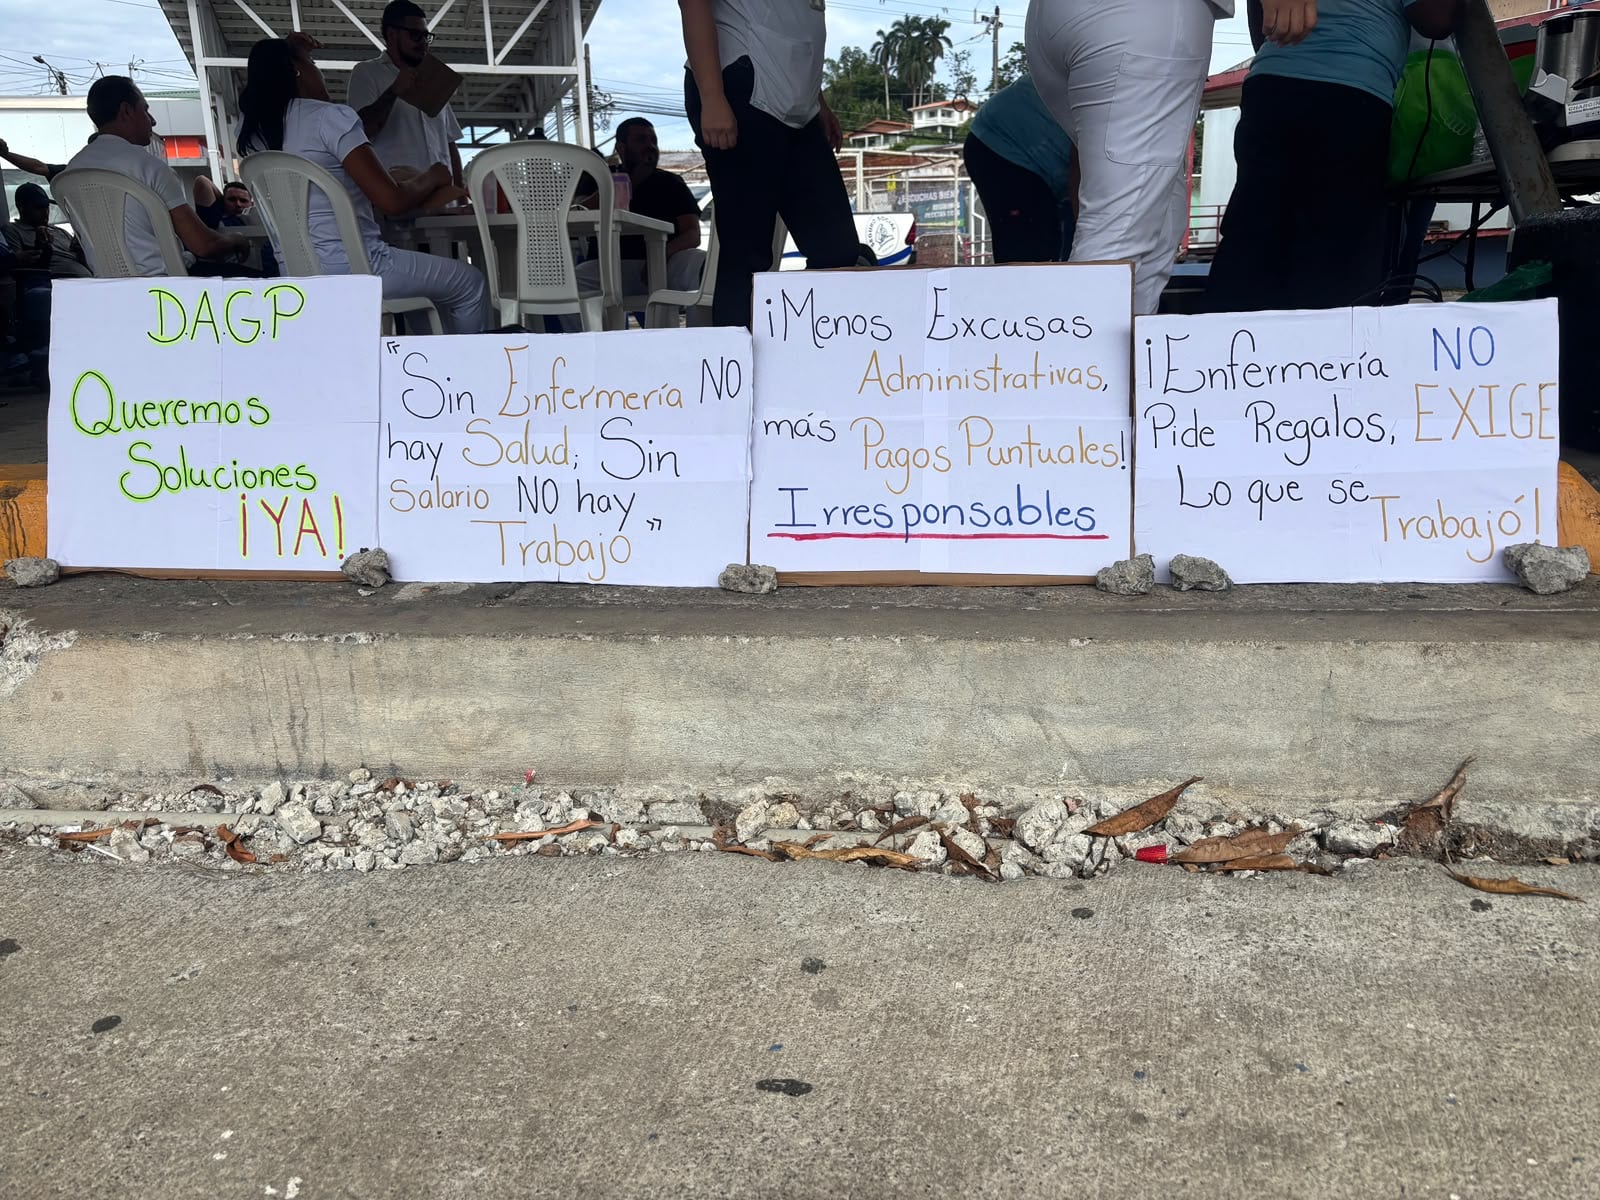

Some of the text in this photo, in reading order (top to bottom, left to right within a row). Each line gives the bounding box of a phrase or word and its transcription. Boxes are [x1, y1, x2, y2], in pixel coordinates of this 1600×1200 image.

[766, 286, 1093, 350] ¡Menos Excusas
[498, 345, 683, 417] Enfermería
[700, 357, 742, 404] NO
[857, 350, 1109, 397] Administrativas,
[1145, 326, 1496, 395] ¡Enfermería NO
[70, 371, 271, 437] Queremos
[1143, 383, 1557, 467] Pide Regalos, EXIGE
[119, 442, 318, 502] Soluciones
[387, 417, 681, 482] hay Salud; Sin
[763, 411, 1128, 496] más Pagos Puntuales!
[240, 492, 345, 560] ¡YA!
[389, 475, 636, 533] Salario NO hay
[774, 484, 1096, 543] Irresponsables
[1177, 465, 1542, 564] Lo que se Trabajó!
